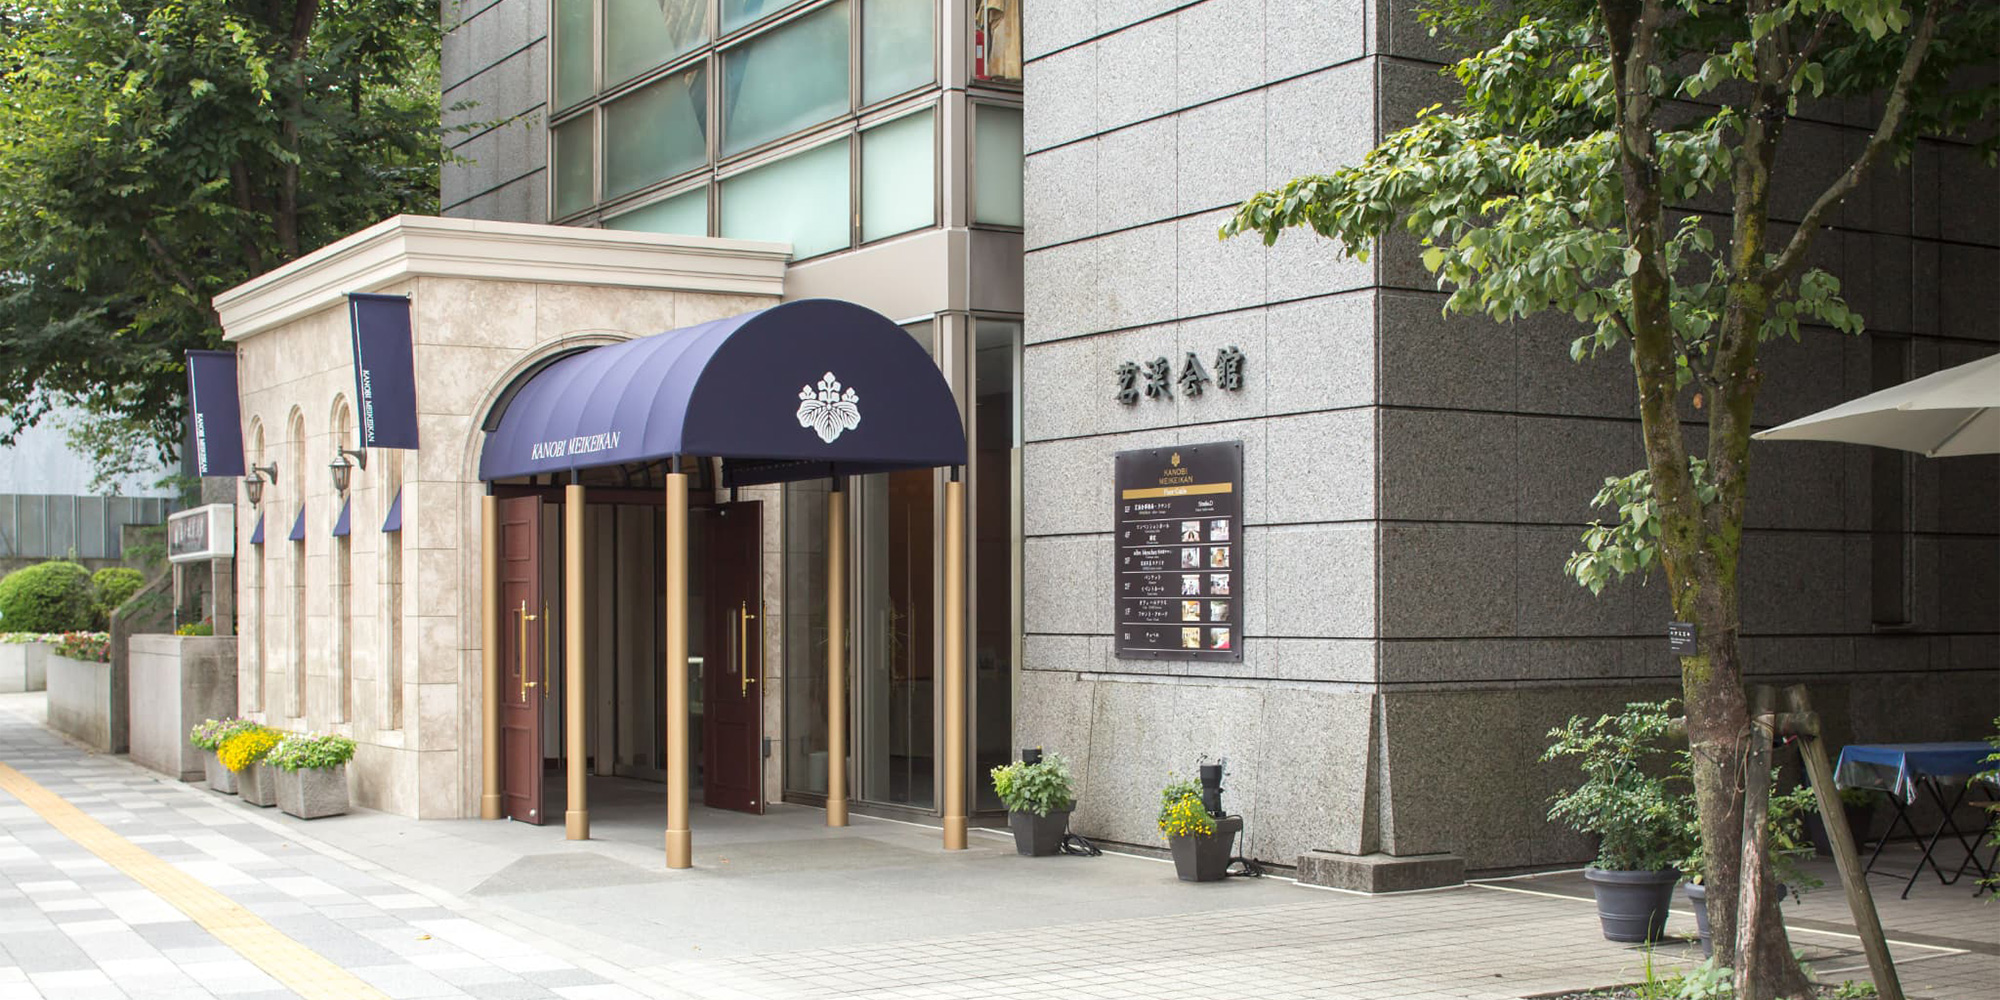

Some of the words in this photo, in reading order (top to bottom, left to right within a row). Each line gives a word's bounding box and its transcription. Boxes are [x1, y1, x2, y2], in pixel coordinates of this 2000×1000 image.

[363, 369, 371, 398] KANOBI
[365, 401, 375, 442] MEIKEIKAN
[531, 440, 567, 460] KANOBI
[567, 431, 621, 456] MEIKEIKAN
[1158, 475, 1193, 485] MEIKEIKAN
[1163, 467, 1188, 477] KANOBI
